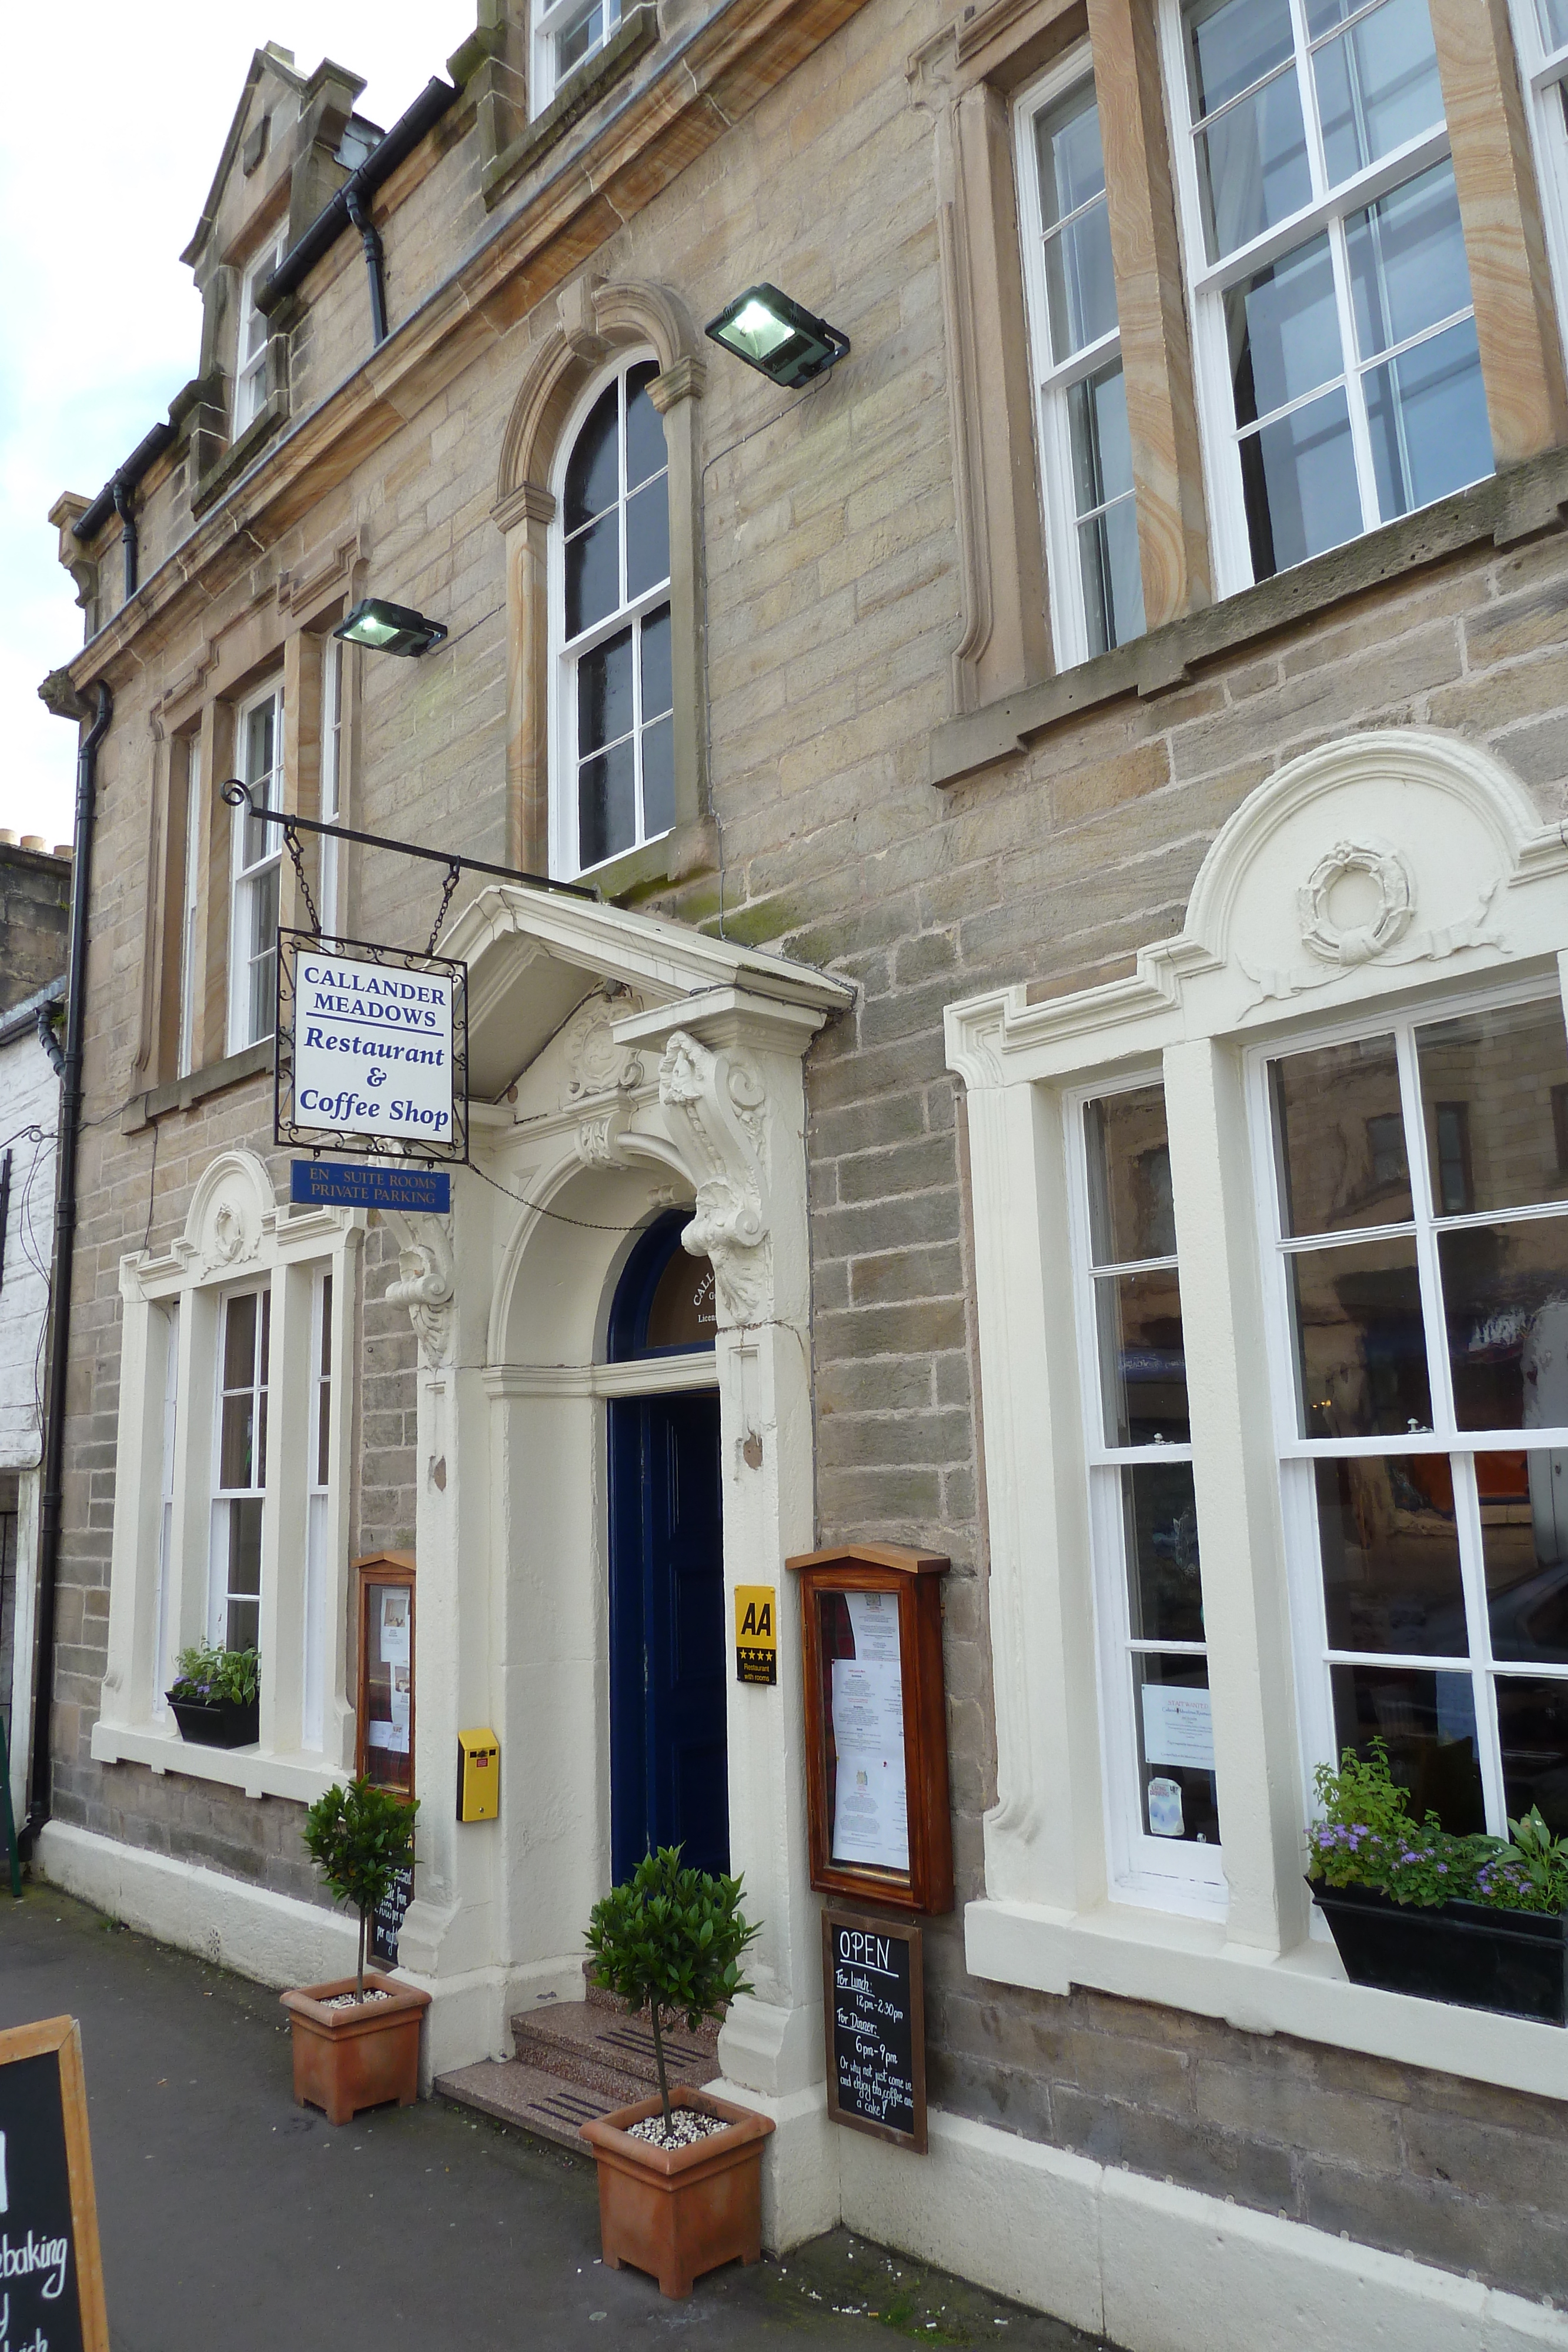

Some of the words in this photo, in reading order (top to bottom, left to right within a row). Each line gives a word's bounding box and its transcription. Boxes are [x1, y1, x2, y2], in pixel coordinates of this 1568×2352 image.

[304, 967, 446, 1005] CALLANDER
[313, 993, 436, 1027] MEADOWS
[303, 1027, 445, 1066] Restaurant
[366, 1067, 387, 1087] &
[300, 1089, 380, 1121] Coffee
[389, 1100, 449, 1132] Shop
[310, 1168, 330, 1180] EN
[343, 1171, 385, 1185] SUITE
[389, 1175, 436, 1189] ROOMS
[312, 1183, 369, 1200] PRIVATE
[374, 1188, 436, 1204] PARKING
[697, 1314, 716, 1322] Licen
[741, 1602, 771, 1636] AA
[744, 1663, 770, 1672] Restaurant
[840, 1930, 890, 1970] OPEN
[835, 1968, 848, 1986] For
[851, 1970, 872, 1993] Lunch:
[837, 2007, 848, 2024] For
[850, 2012, 877, 2035] Dinner:
[840, 2055, 848, 2069] Or
[850, 2059, 861, 2082] why
[862, 2064, 872, 2077] not
[875, 2068, 888, 2089] just
[888, 2076, 904, 2089] come
[905, 2079, 912, 2092] in
[840, 2074, 851, 2087] and
[853, 2075, 871, 2102] enjoy
[883, 2087, 903, 2107] coffee
[857, 2100, 861, 2108] a
